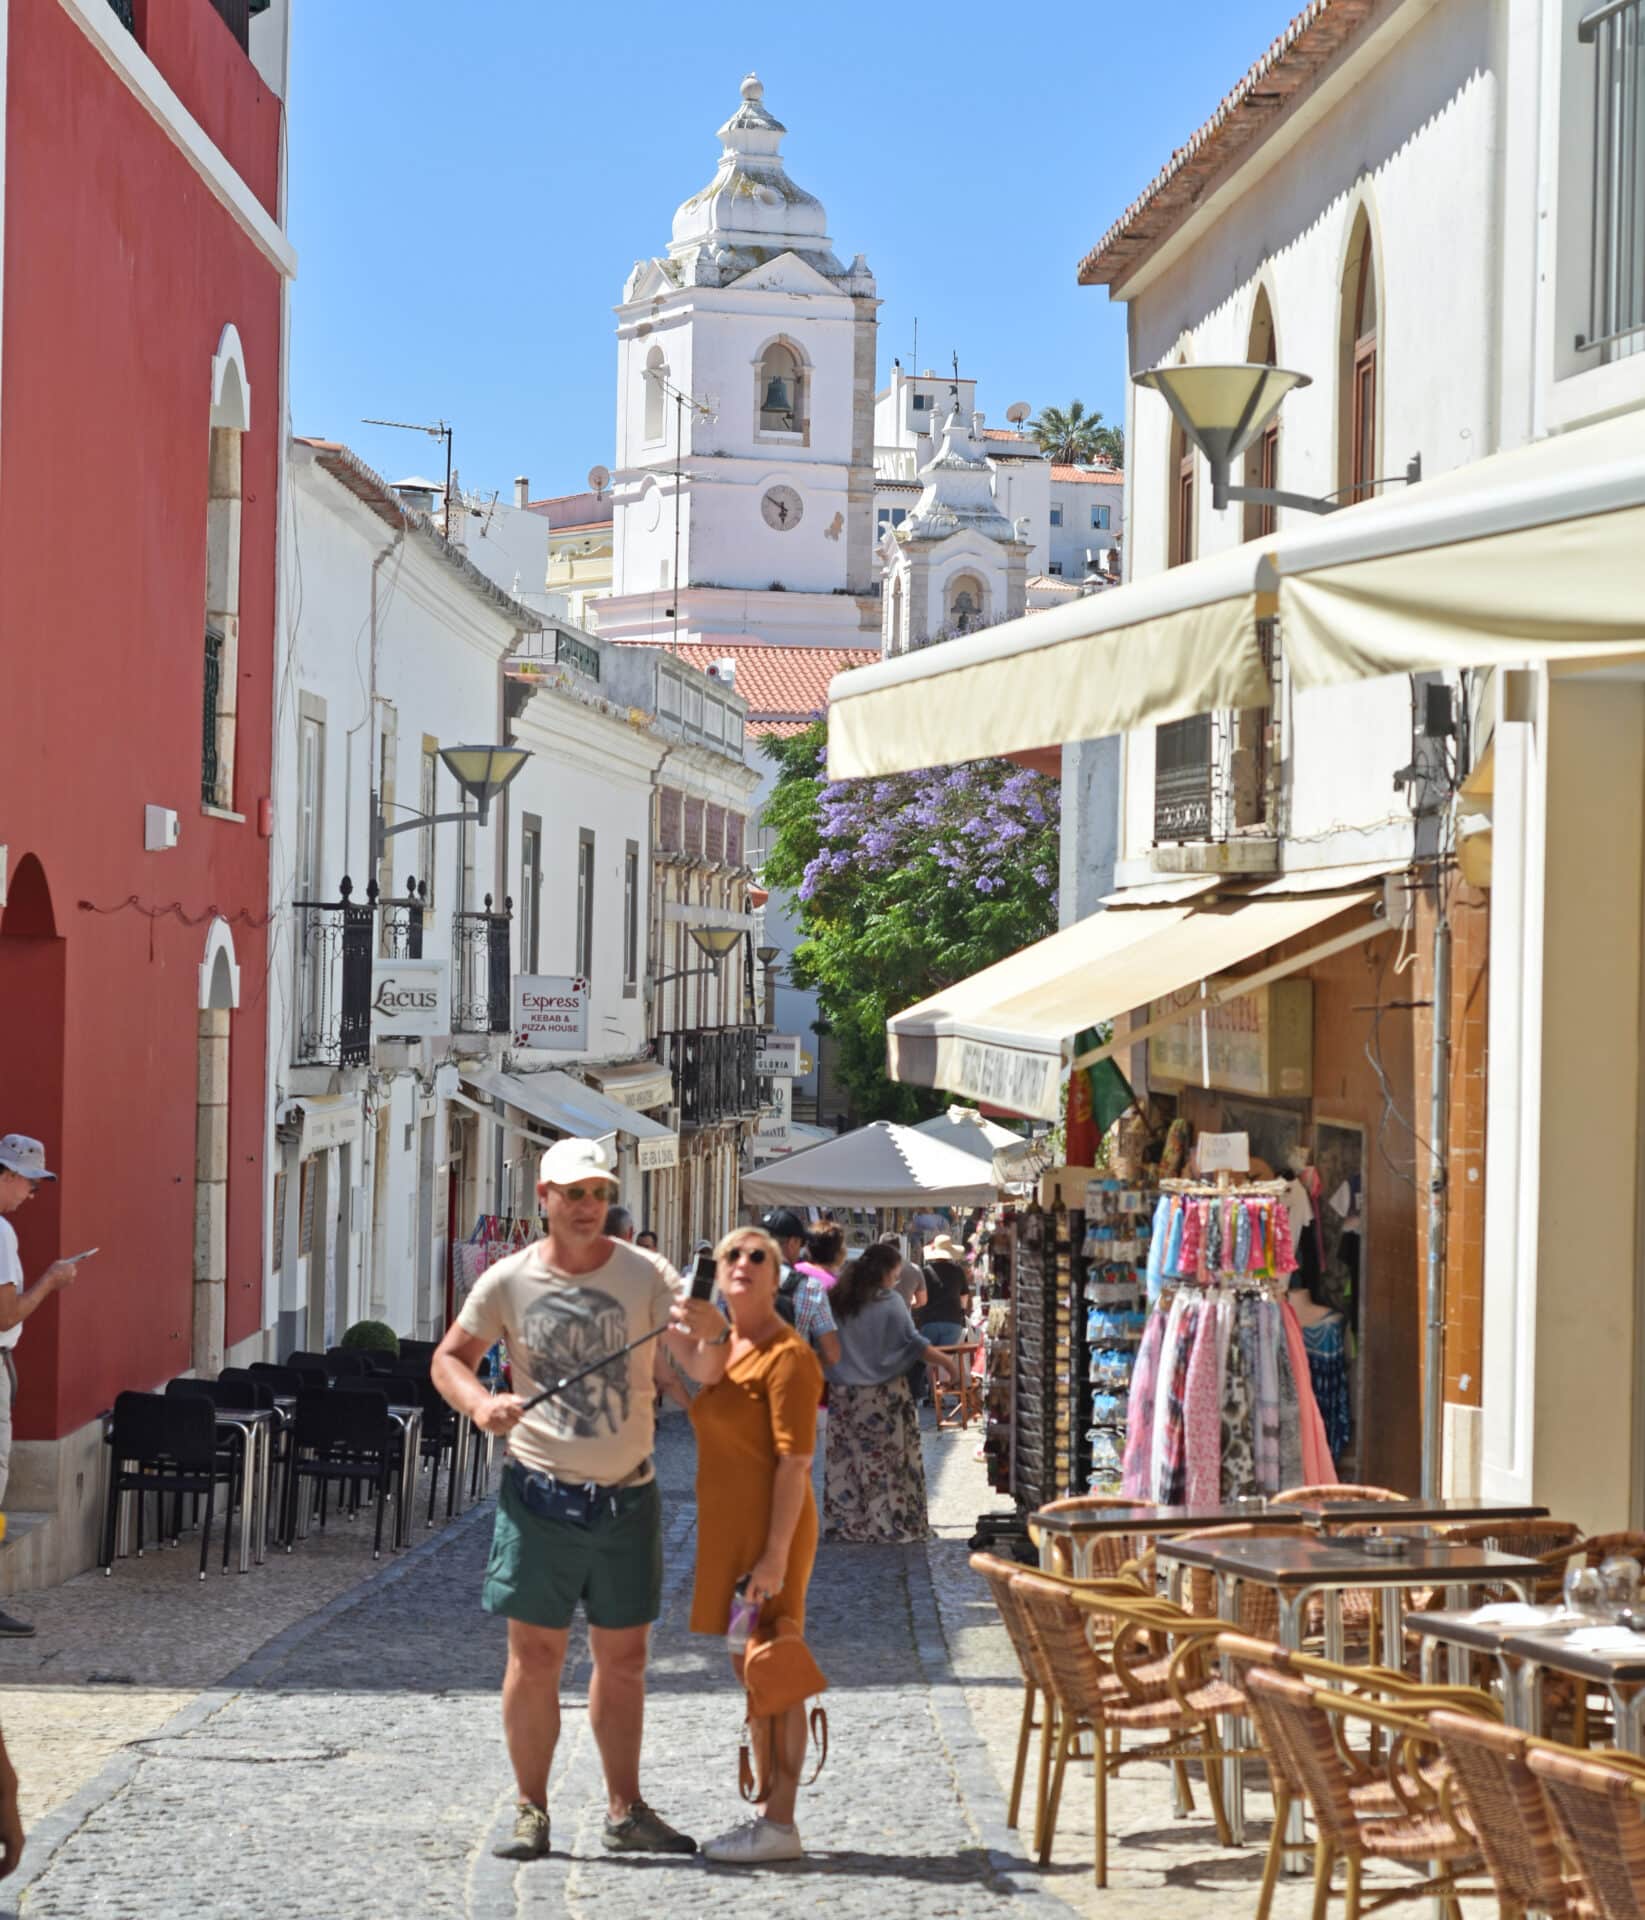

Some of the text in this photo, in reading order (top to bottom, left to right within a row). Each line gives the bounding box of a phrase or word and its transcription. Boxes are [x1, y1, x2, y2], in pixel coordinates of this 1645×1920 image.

[371, 978, 438, 1018] Lacus
[522, 992, 580, 1012] Express
[531, 1015, 570, 1023] KEBAB &
[522, 1023, 579, 1032] PIZZA HOUSE
